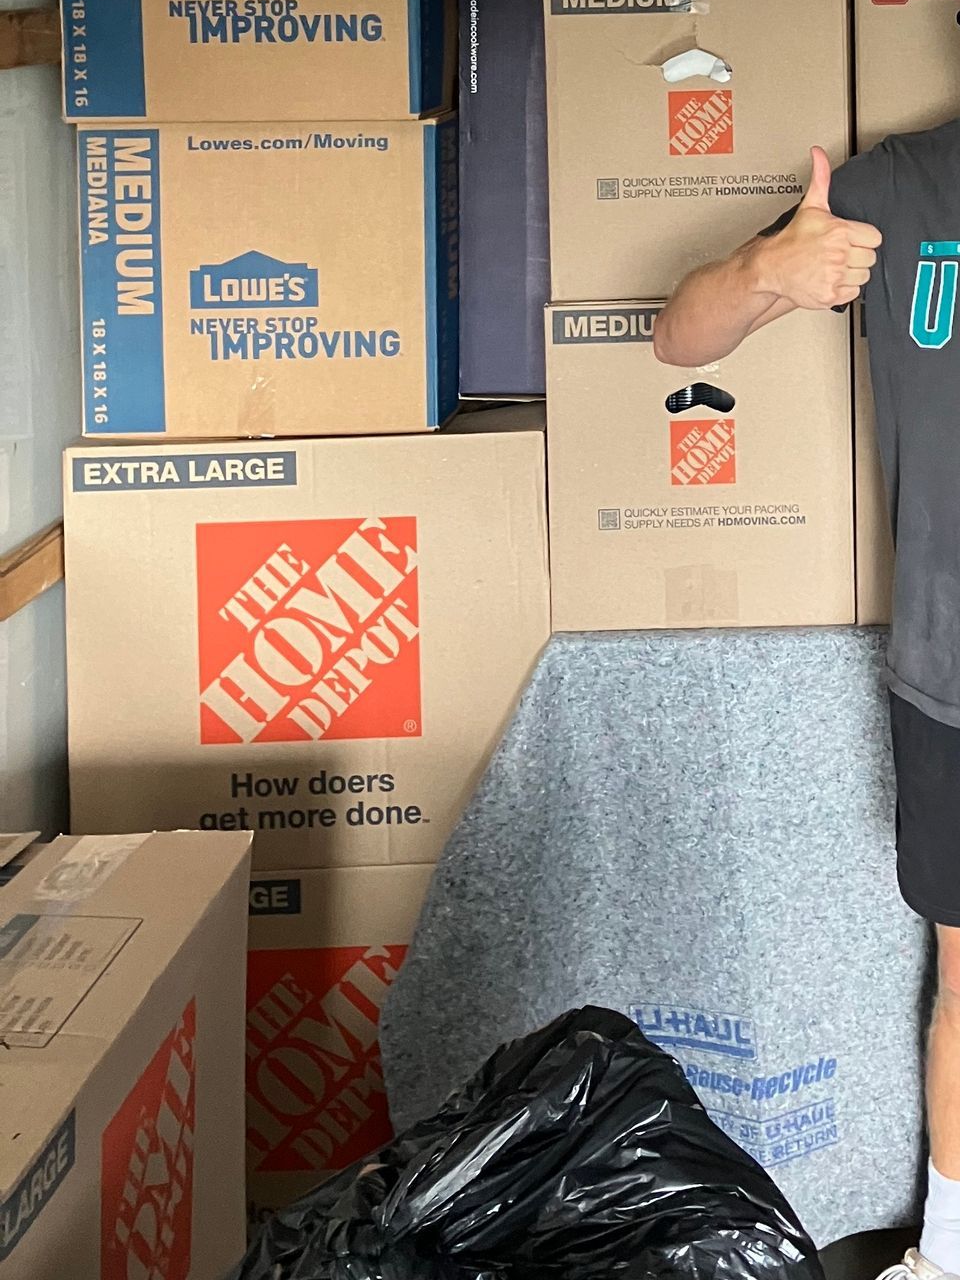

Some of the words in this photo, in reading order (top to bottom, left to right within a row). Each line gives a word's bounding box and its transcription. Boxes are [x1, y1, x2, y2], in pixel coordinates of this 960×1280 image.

[71, 0, 85, 19] 18
[168, 0, 239, 18] NEVER
[244, 0, 299, 18] STOP
[73, 25, 86, 38] X
[189, 13, 384, 44] IMPROVING
[73, 43, 87, 64] 18
[75, 69, 88, 81] X
[75, 88, 89, 108] 16
[669, 89, 733, 156] HOME
[675, 97, 702, 125] THE
[187, 133, 389, 152] Lowes.com/Moving
[695, 113, 734, 156] DEPOT
[86, 136, 109, 246] MEDIANA
[622, 177, 666, 188] QUICKLY
[669, 176, 718, 187] ESTIMATE
[720, 175, 749, 185] YOUR
[751, 173, 797, 184] PACKING
[622, 188, 662, 199] SUPPLY
[664, 187, 700, 198] NEEDS
[701, 187, 714, 197] AT
[715, 184, 803, 196] HDMOVING.COM
[113, 137, 154, 316] MEDIUM
[203, 273, 306, 302] LOWE'S
[92, 318, 106, 338] 18
[190, 316, 258, 336] NEVER
[265, 316, 318, 335] STOP
[564, 314, 655, 338] MEDIU
[95, 343, 107, 356] X
[210, 329, 401, 360] IMPROVING
[94, 361, 107, 382] 18
[95, 387, 108, 399] X
[95, 405, 109, 425] 16
[677, 425, 703, 455] THE
[671, 419, 735, 486] HOME
[697, 442, 736, 485] DEPOT
[83, 460, 181, 486] EXTRA
[188, 456, 286, 483] LARGE
[624, 507, 668, 518] QUICKLY
[671, 506, 720, 516] ESTIMATE
[722, 505, 752, 515] YOUR
[754, 503, 800, 514] PACKING
[624, 518, 664, 529] SUPPLY
[666, 518, 701, 528] NEEDS
[702, 517, 715, 527] AT
[717, 515, 806, 526] HDMOVING.COM
[218, 543, 312, 635] THE
[200, 517, 419, 744] HOME
[286, 597, 421, 742] DEPOT
[230, 772, 300, 799] How
[308, 769, 395, 795] doers
[258, 805, 337, 829] more
[772, 1124, 838, 1160] RETURN
